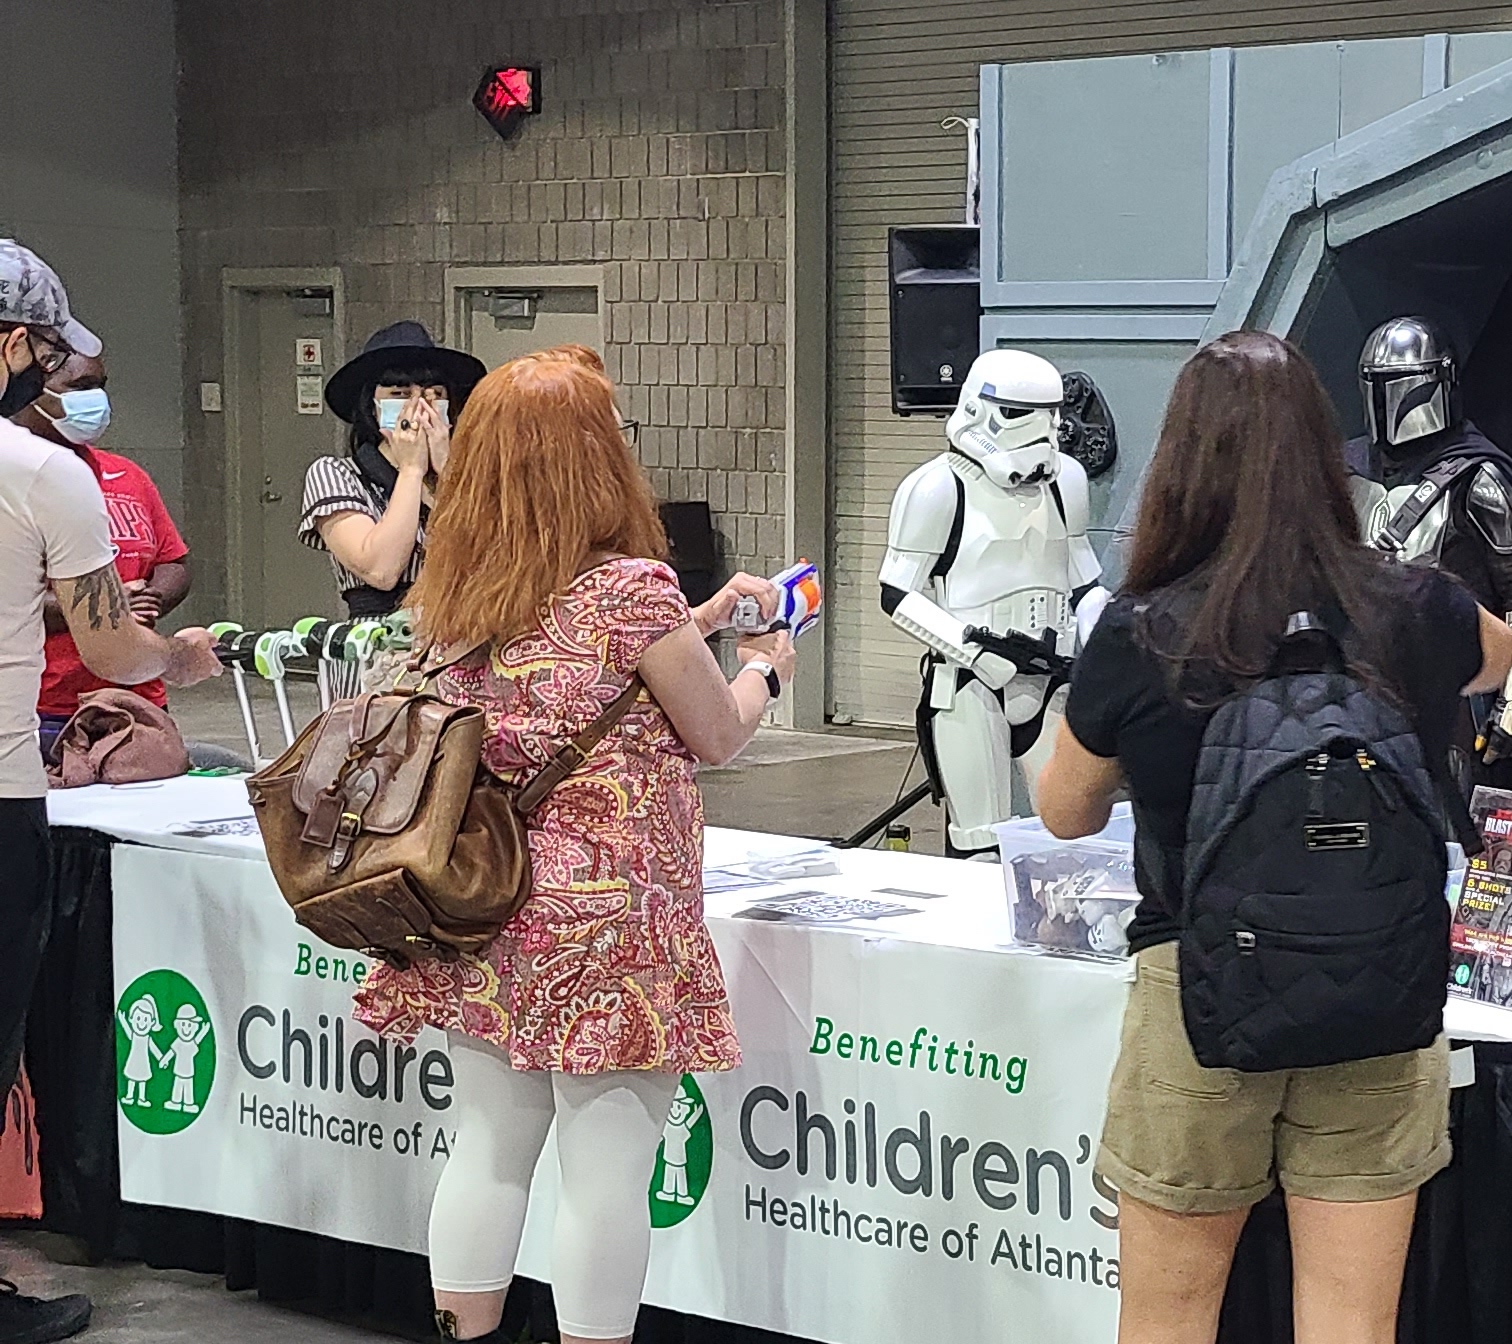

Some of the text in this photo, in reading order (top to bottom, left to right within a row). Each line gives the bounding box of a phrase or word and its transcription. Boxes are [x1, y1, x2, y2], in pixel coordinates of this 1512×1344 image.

[1463, 890, 1505, 906] SPECIAL
[809, 1015, 1029, 1094] Benefiting
[239, 1091, 384, 1151] Healthcare
[393, 1120, 423, 1157] of
[738, 1084, 1120, 1229] Children's
[743, 1183, 1121, 1291] Healthcare of Atlanta
